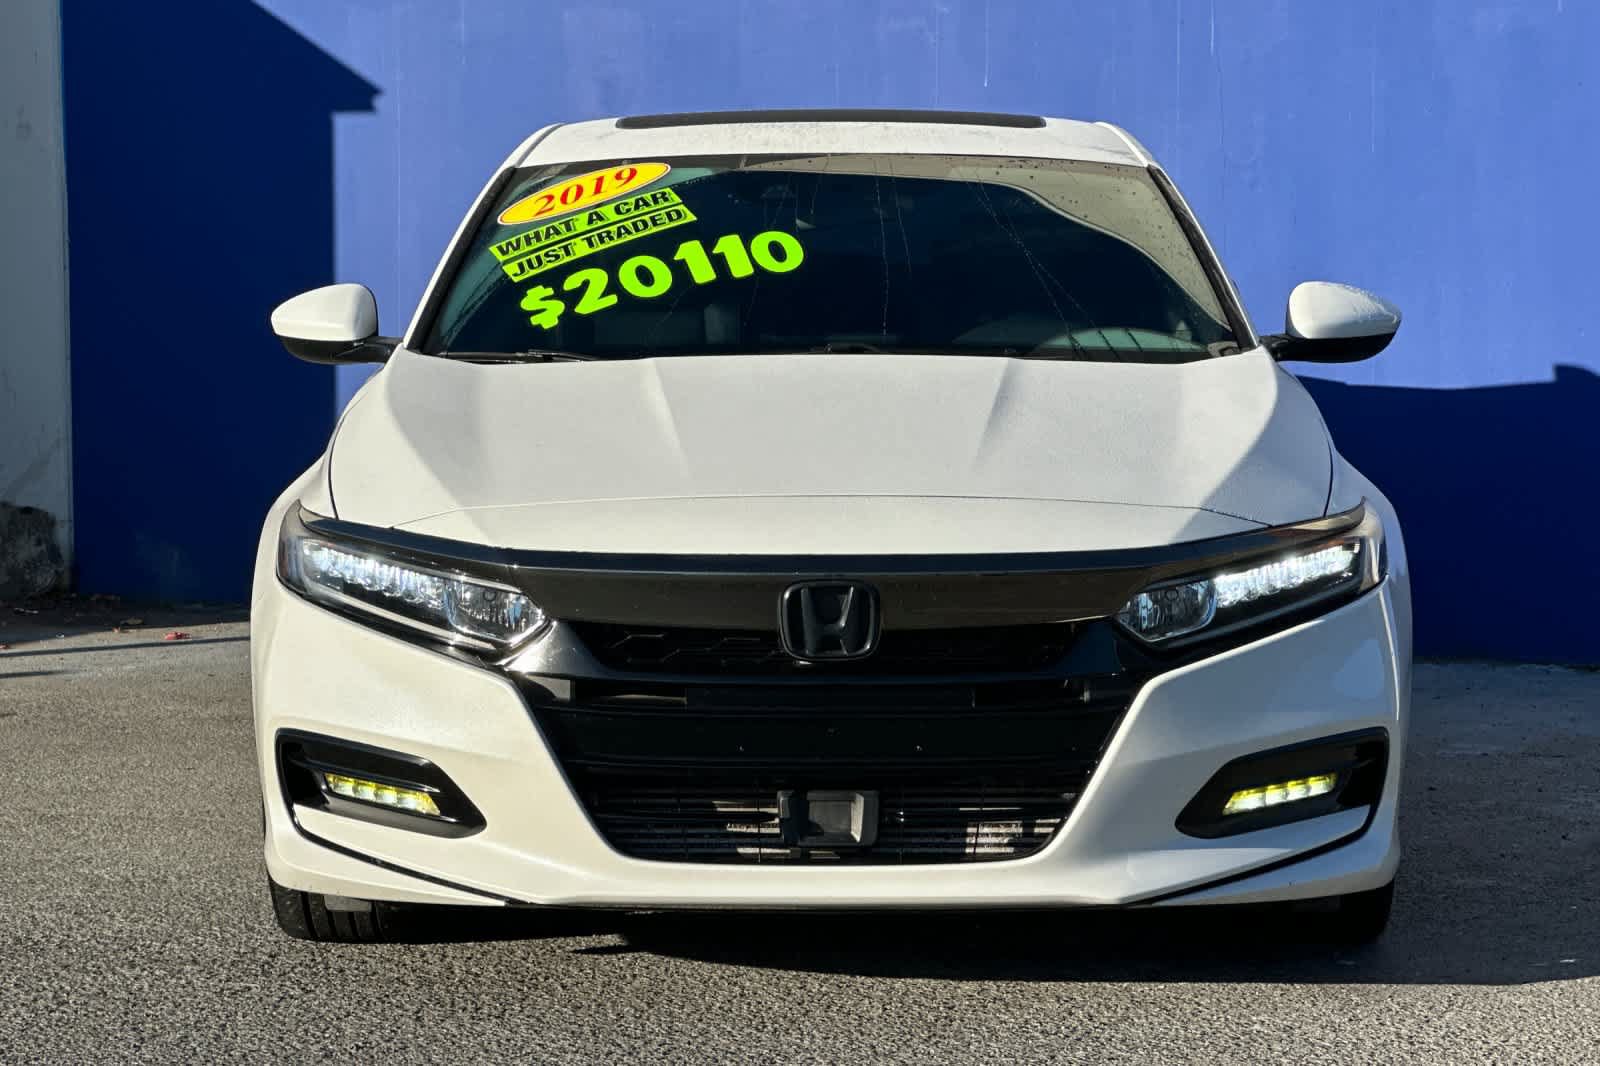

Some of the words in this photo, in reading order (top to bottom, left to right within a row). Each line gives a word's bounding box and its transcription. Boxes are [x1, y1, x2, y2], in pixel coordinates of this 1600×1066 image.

[496, 220, 576, 257] WHAT
[587, 210, 607, 227] A
[613, 190, 672, 216] CAR
[532, 167, 638, 217] 2019
[512, 241, 577, 278] JUST
[584, 207, 688, 251] TRADED
[520, 231, 804, 329] $20110
